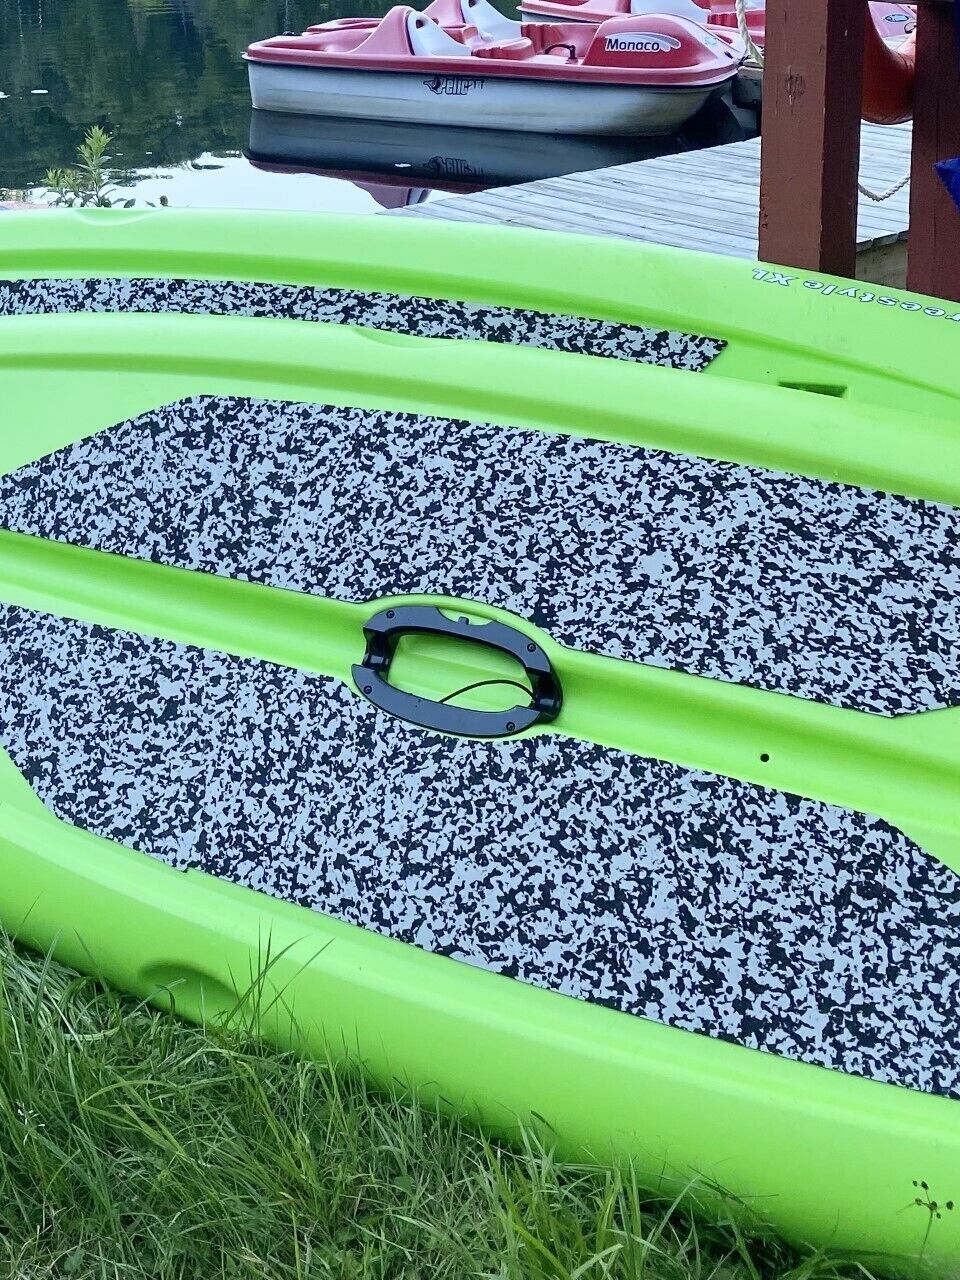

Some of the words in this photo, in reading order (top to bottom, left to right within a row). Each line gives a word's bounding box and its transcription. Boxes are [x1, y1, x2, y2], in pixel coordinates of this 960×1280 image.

[606, 38, 660, 51] Monaco
[752, 268, 799, 286] XL
[803, 279, 960, 322] reestyle
